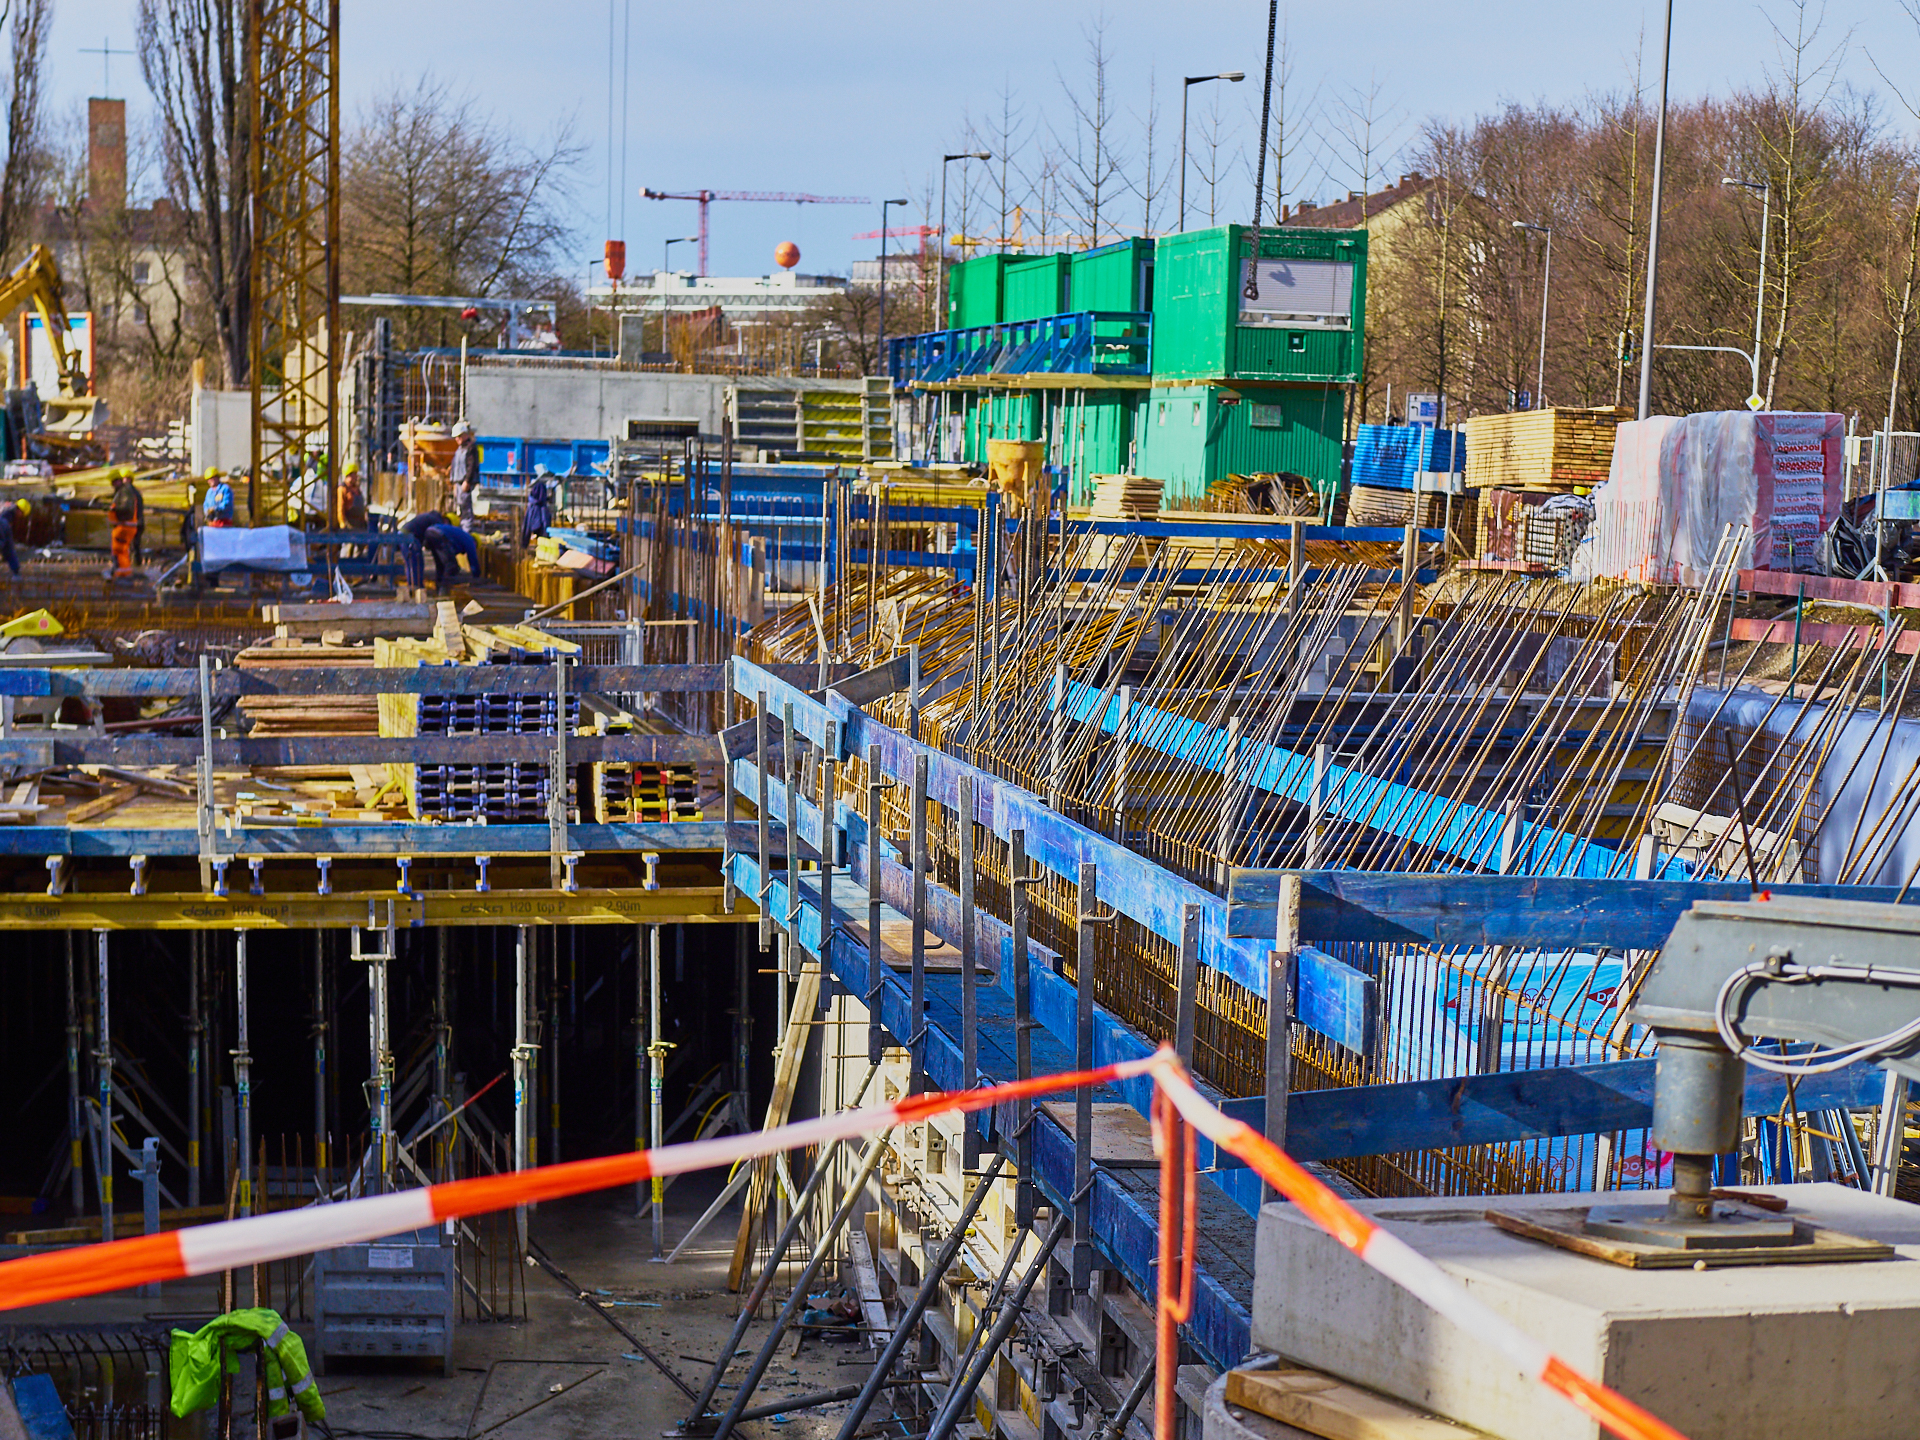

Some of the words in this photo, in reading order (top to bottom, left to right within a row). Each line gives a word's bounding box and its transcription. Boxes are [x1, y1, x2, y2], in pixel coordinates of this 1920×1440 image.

[1774, 505, 1821, 513] ROCKWOOL
[182, 905, 225, 916] doka
[259, 905, 277, 919] top
[279, 904, 289, 916] P
[459, 901, 502, 913] doka
[509, 901, 530, 913] H20
[536, 901, 554, 913] top
[557, 901, 565, 913] P
[605, 900, 640, 912] 2.90m
